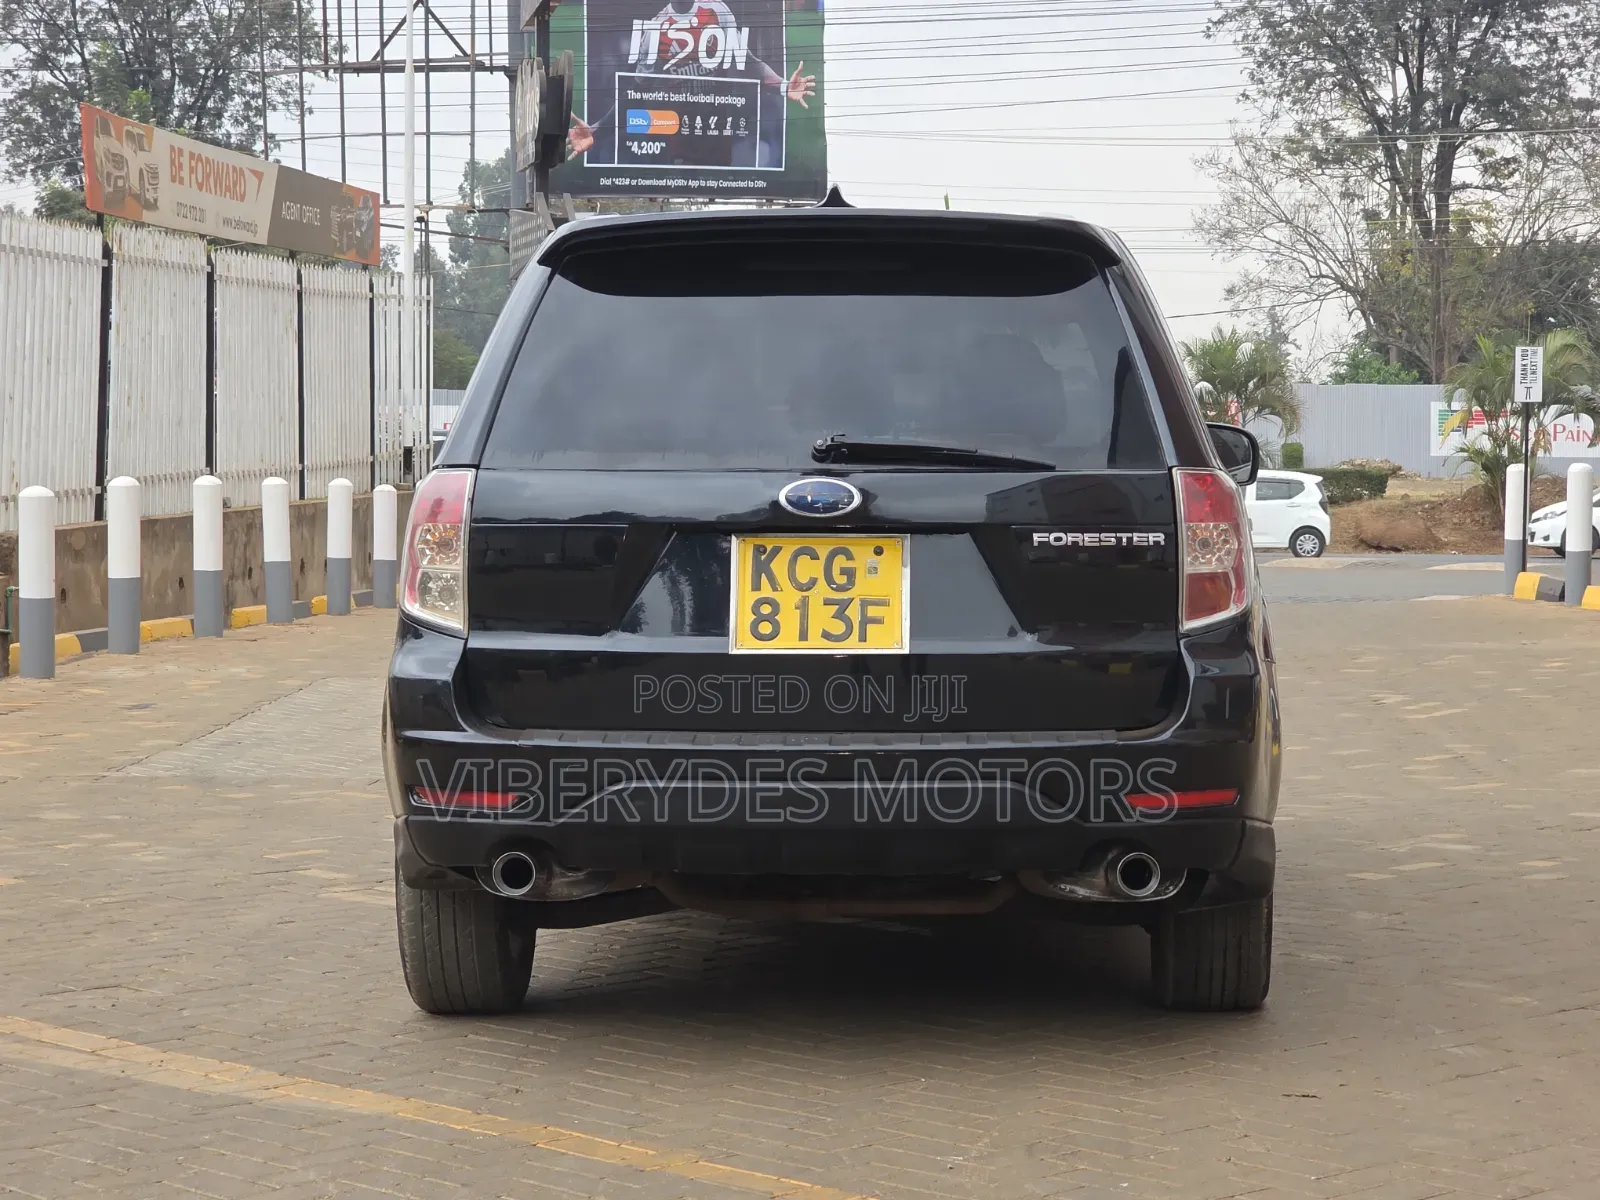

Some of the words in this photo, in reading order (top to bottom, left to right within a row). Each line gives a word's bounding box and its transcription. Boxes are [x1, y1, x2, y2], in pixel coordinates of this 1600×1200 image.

[698, 25, 749, 70] ON
[626, 90, 641, 99] The
[642, 91, 668, 101] world's
[670, 92, 686, 102] best
[687, 93, 714, 103] football
[715, 95, 745, 107] package
[169, 144, 184, 186] BE
[188, 150, 247, 202] FORWARD
[600, 177, 611, 186] Dial
[638, 178, 667, 186] Download
[667, 178, 688, 188] MyDStv
[688, 179, 699, 189] App
[707, 180, 718, 189] stay
[748, 180, 754, 188] to
[754, 180, 767, 188] DStv
[281, 201, 301, 221] AGENT
[301, 205, 321, 226] OFFICE
[1520, 348, 1529, 361] YOU
[1520, 363, 1529, 384] THANK
[1529, 360, 1538, 375] NEXT
[1032, 532, 1165, 547] FORESTER
[751, 544, 857, 593] KCG
[750, 595, 891, 643] 813F
